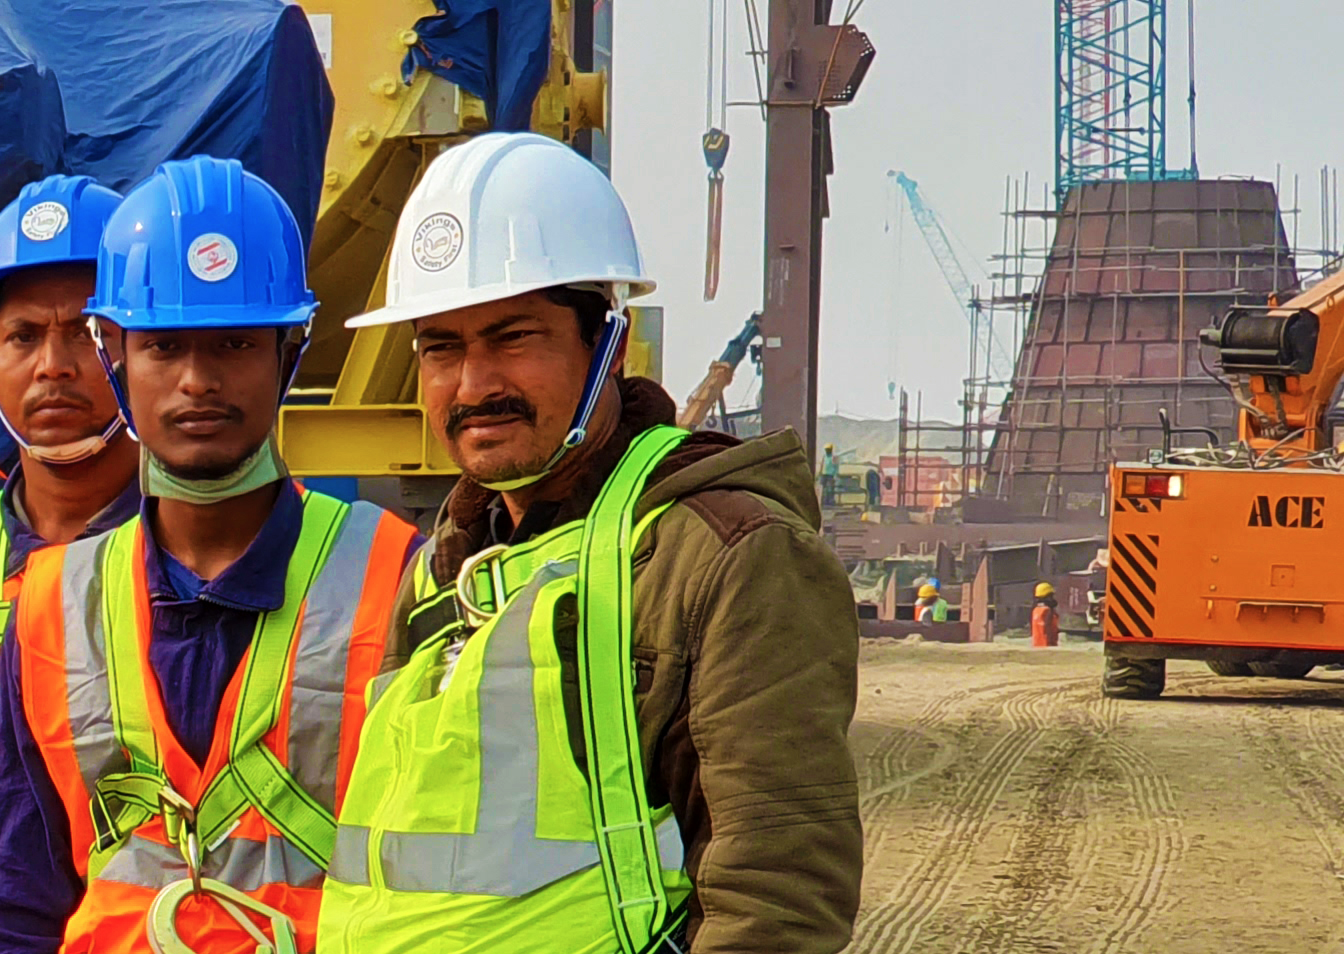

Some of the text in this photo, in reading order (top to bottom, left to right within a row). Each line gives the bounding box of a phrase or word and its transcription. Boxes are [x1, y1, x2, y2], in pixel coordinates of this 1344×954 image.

[25, 204, 66, 217] Vikings
[415, 218, 456, 242] Vikings
[419, 255, 442, 268] Safety
[1247, 495, 1326, 529] ACE
